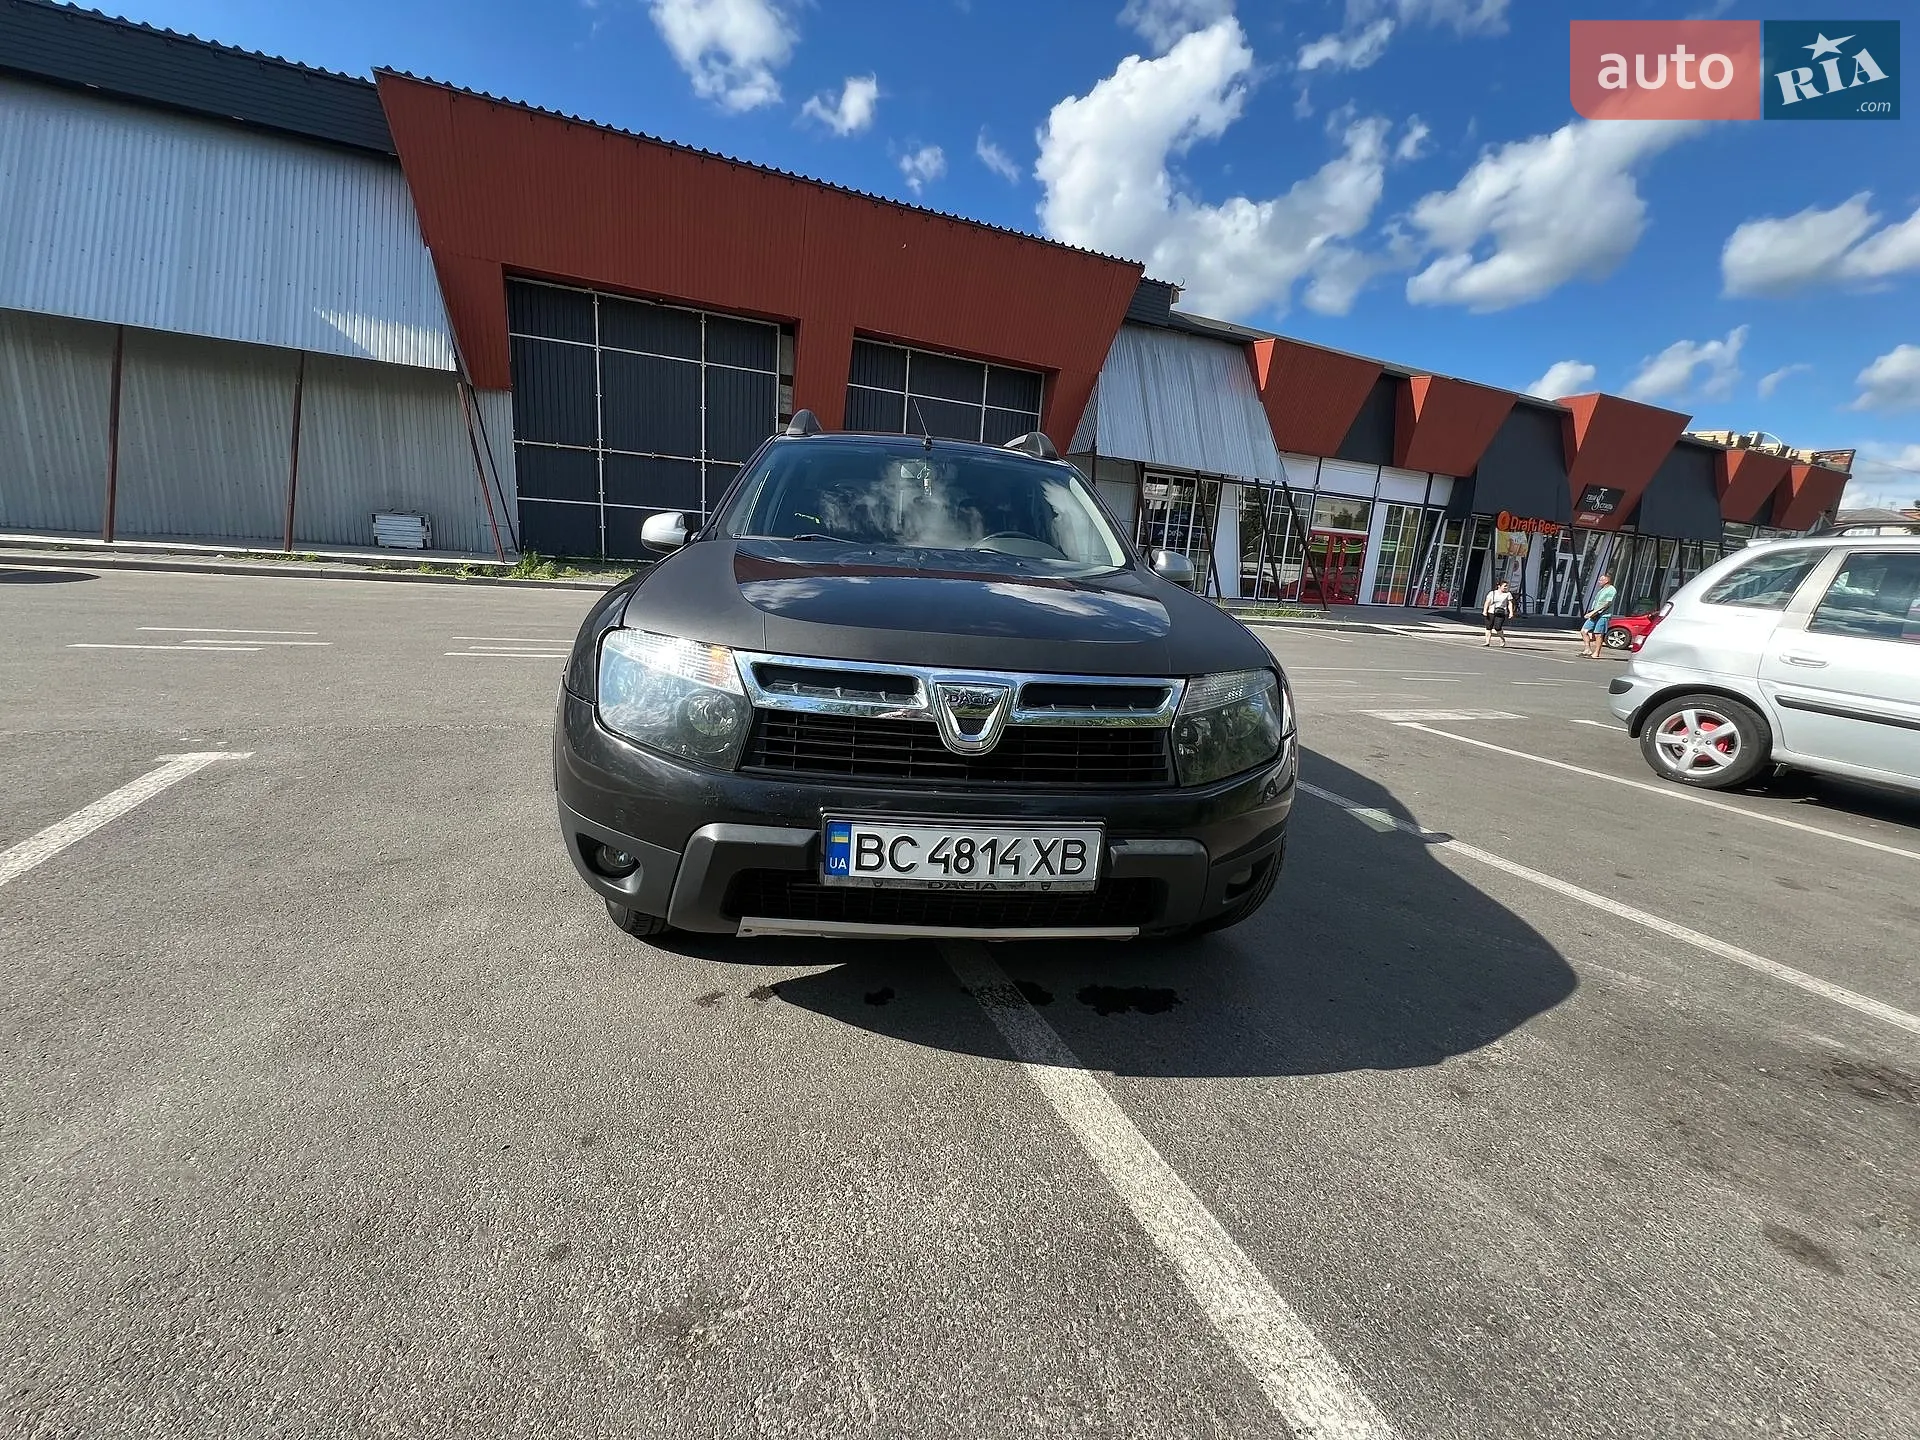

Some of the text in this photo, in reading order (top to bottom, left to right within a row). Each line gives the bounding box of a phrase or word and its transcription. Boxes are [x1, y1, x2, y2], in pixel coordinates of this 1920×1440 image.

[1511, 517, 1560, 535] Draft Beer
[949, 694, 995, 706] DACIA
[855, 833, 1088, 876] BC 4814 XB
[829, 857, 848, 870] UA
[927, 881, 998, 891] DACIA
